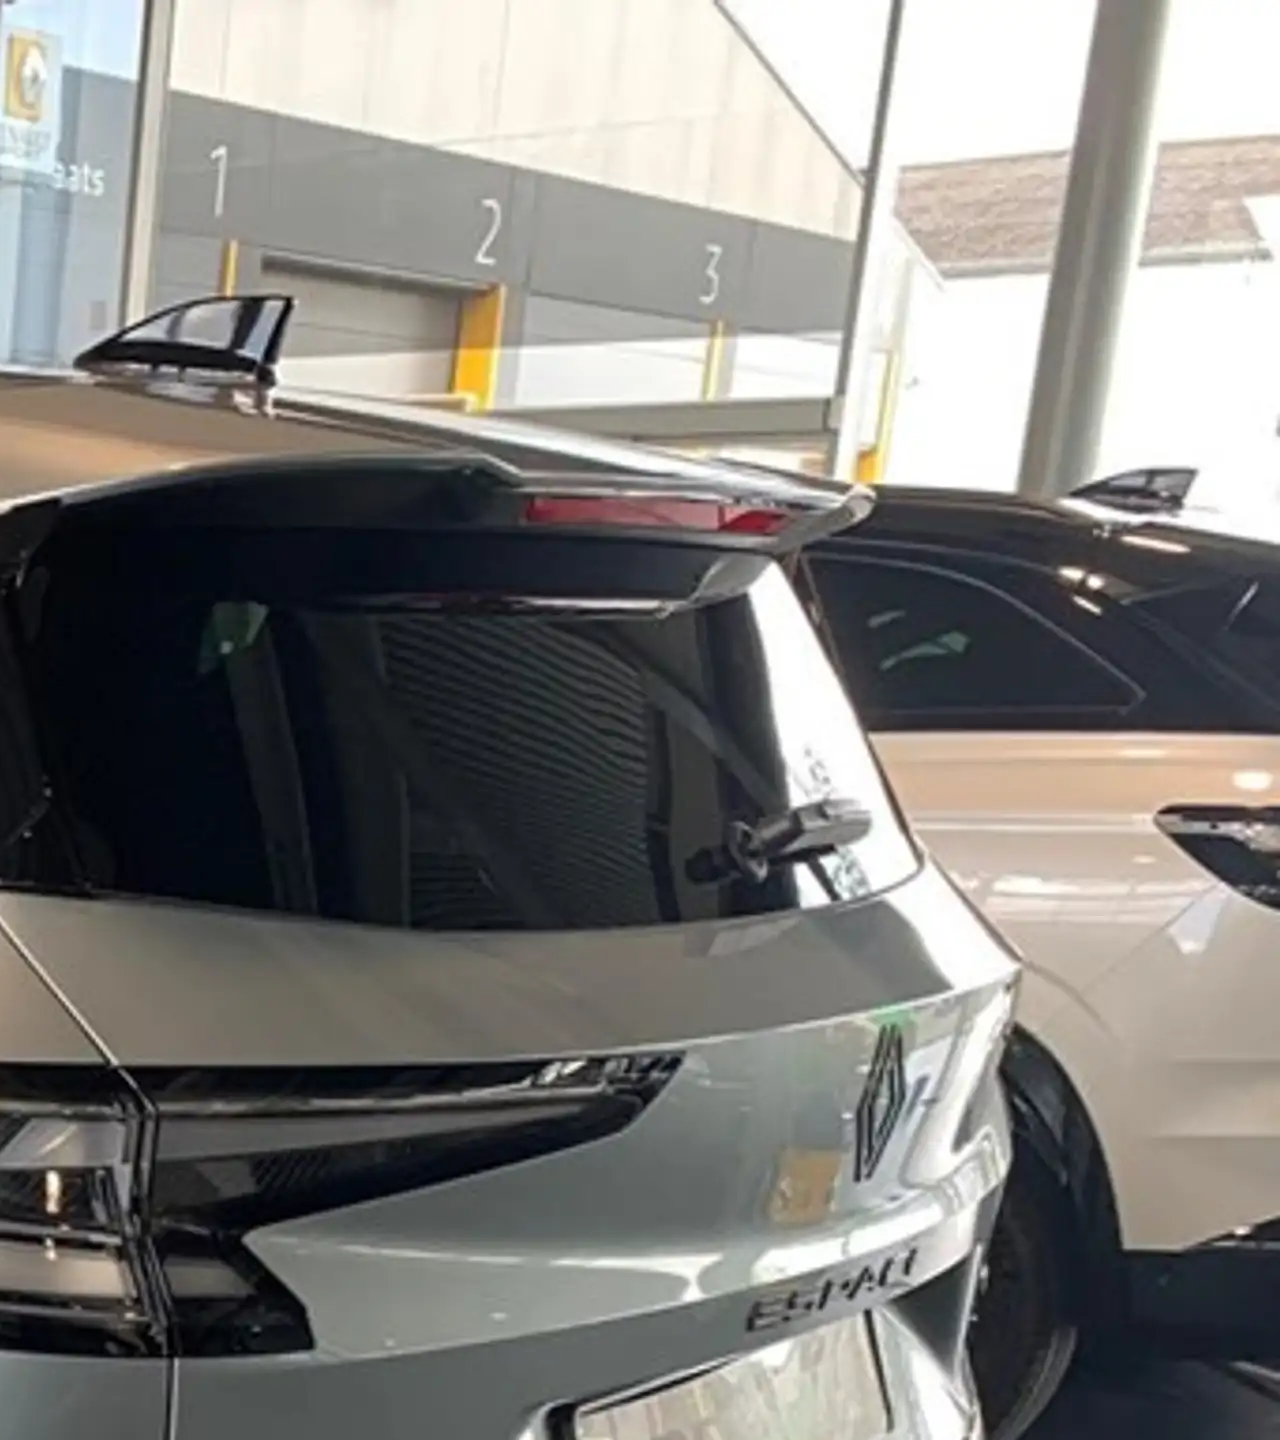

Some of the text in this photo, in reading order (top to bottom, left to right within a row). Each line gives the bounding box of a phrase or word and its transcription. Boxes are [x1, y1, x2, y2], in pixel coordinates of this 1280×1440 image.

[210, 146, 227, 217] 1
[475, 199, 501, 266] 2
[699, 243, 723, 304] 3
